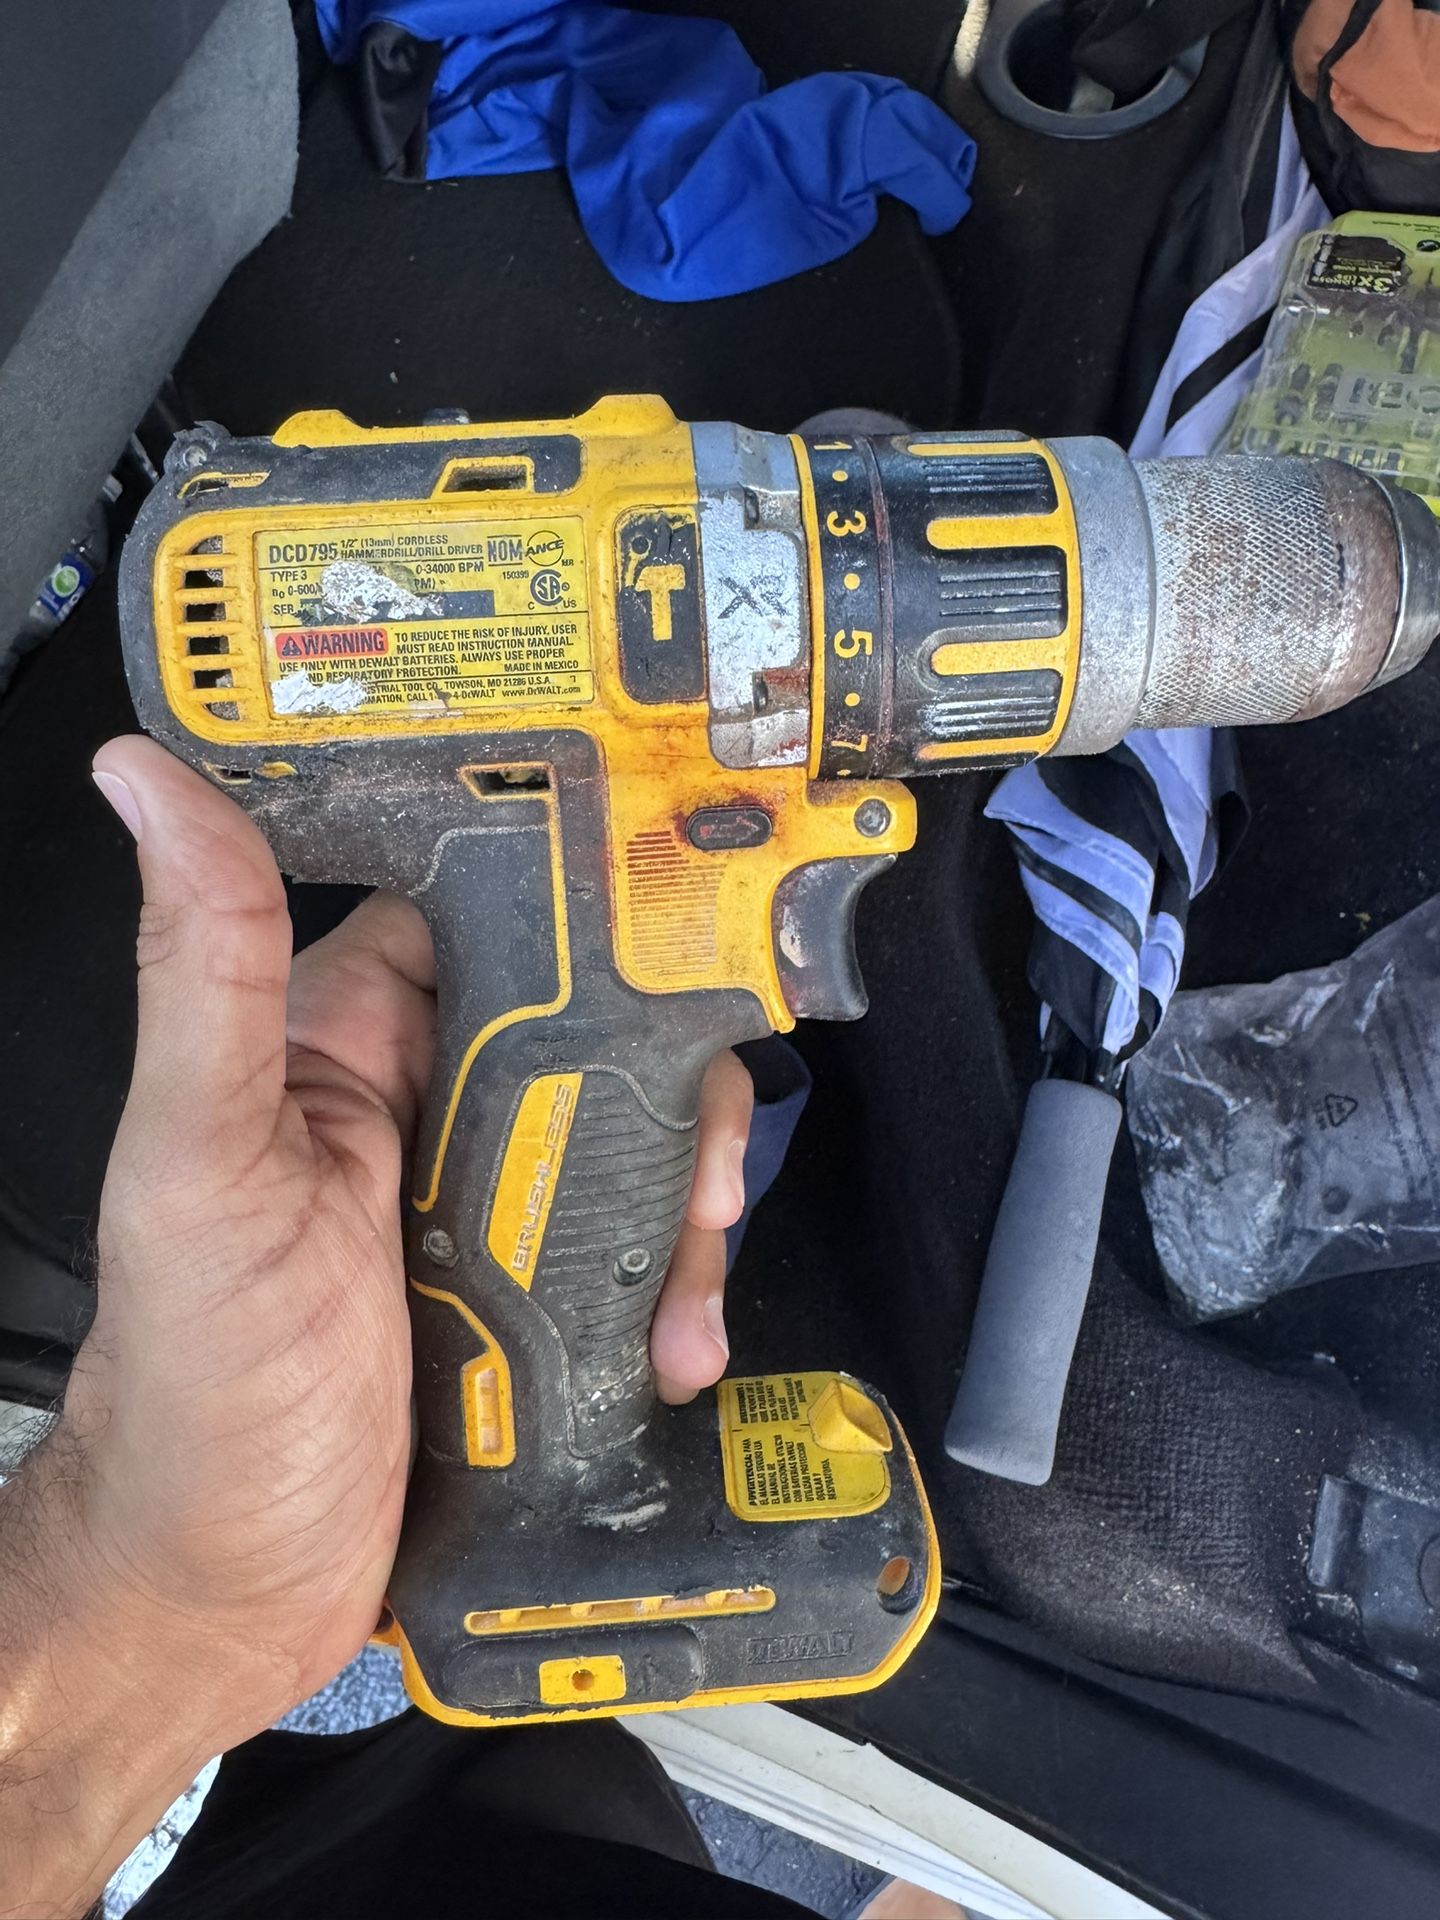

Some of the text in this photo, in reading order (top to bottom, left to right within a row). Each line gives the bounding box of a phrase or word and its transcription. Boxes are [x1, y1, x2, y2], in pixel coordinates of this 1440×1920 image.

[826, 510, 867, 537] 3
[360, 537, 395, 549] (13mm)
[397, 534, 448, 546] CORDLESS
[447, 544, 483, 556] DRIVER
[525, 538, 564, 557] ANCE
[269, 542, 338, 564] DCD795
[488, 539, 523, 562] NOM
[458, 561, 484, 573] BPM
[271, 570, 307, 582] TYPE 3
[563, 599, 577, 609] US
[395, 633, 408, 643] TO
[411, 630, 449, 642] REDUCE
[451, 629, 470, 640] THE
[473, 628, 494, 638] RISK
[497, 627, 510, 637] OF
[552, 624, 577, 634] USER
[302, 631, 385, 655] WARNING
[397, 643, 425, 654] MUST
[429, 642, 455, 653] READ
[458, 638, 525, 651] INSTRUCTION
[834, 629, 873, 659] 5
[279, 661, 299, 673] USE
[329, 659, 358, 670] WITH
[359, 656, 401, 669] DEWALT
[402, 654, 459, 666] BATTERIES.
[461, 652, 502, 663] ALWAYS
[504, 651, 524, 661] USE
[526, 648, 565, 659] PROPER
[504, 660, 579, 672] MADE IN MEXICO
[305, 672, 324, 683] ND
[396, 665, 462, 678] PROTECTION.
[402, 683, 425, 692] TOOL
[406, 692, 428, 701] CALL
[831, 735, 867, 752] 7
[511, 1083, 573, 1272] BRUSHLESS
